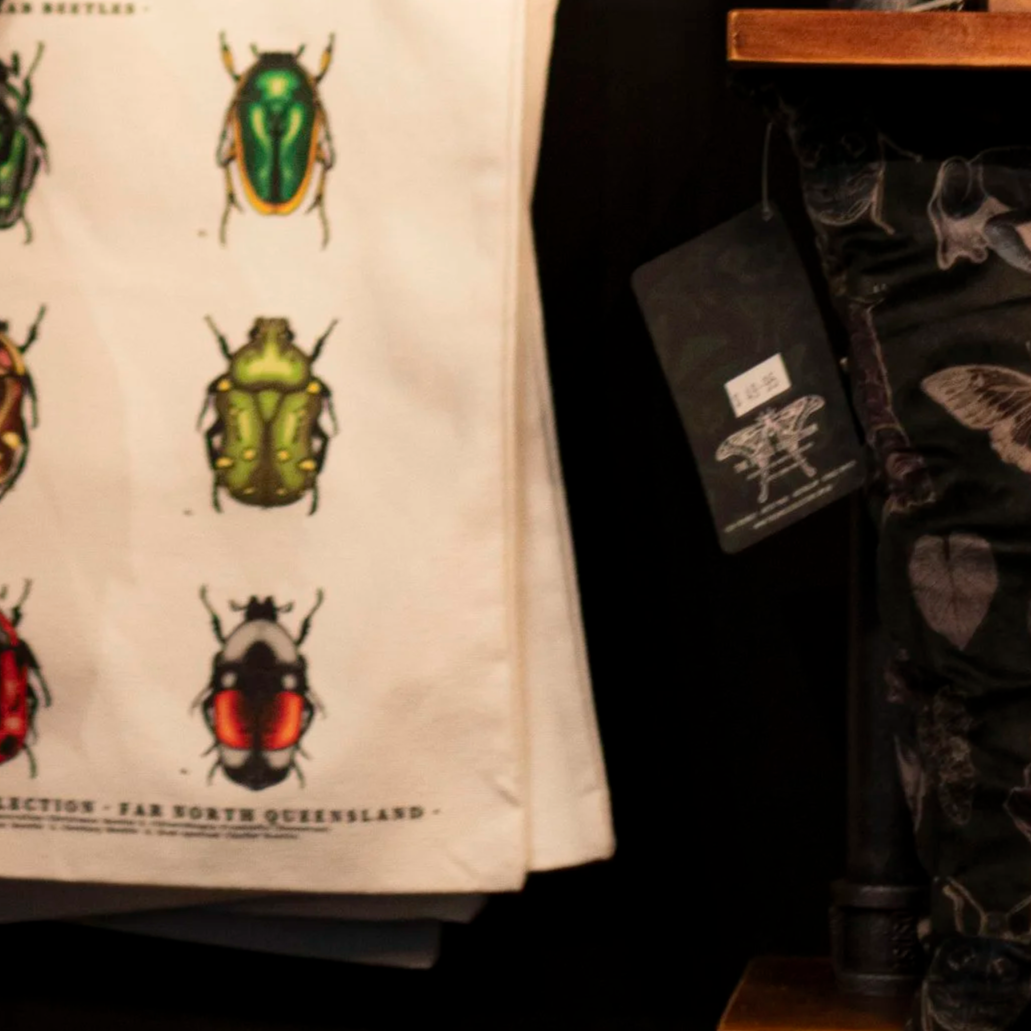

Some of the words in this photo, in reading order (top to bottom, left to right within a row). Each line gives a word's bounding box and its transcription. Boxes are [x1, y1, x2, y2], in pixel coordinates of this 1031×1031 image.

[42, 2, 136, 15] BEETLES
[119, 801, 162, 817] FAR
[173, 804, 255, 822] NORTH
[265, 806, 424, 825] QUEENSLAND
